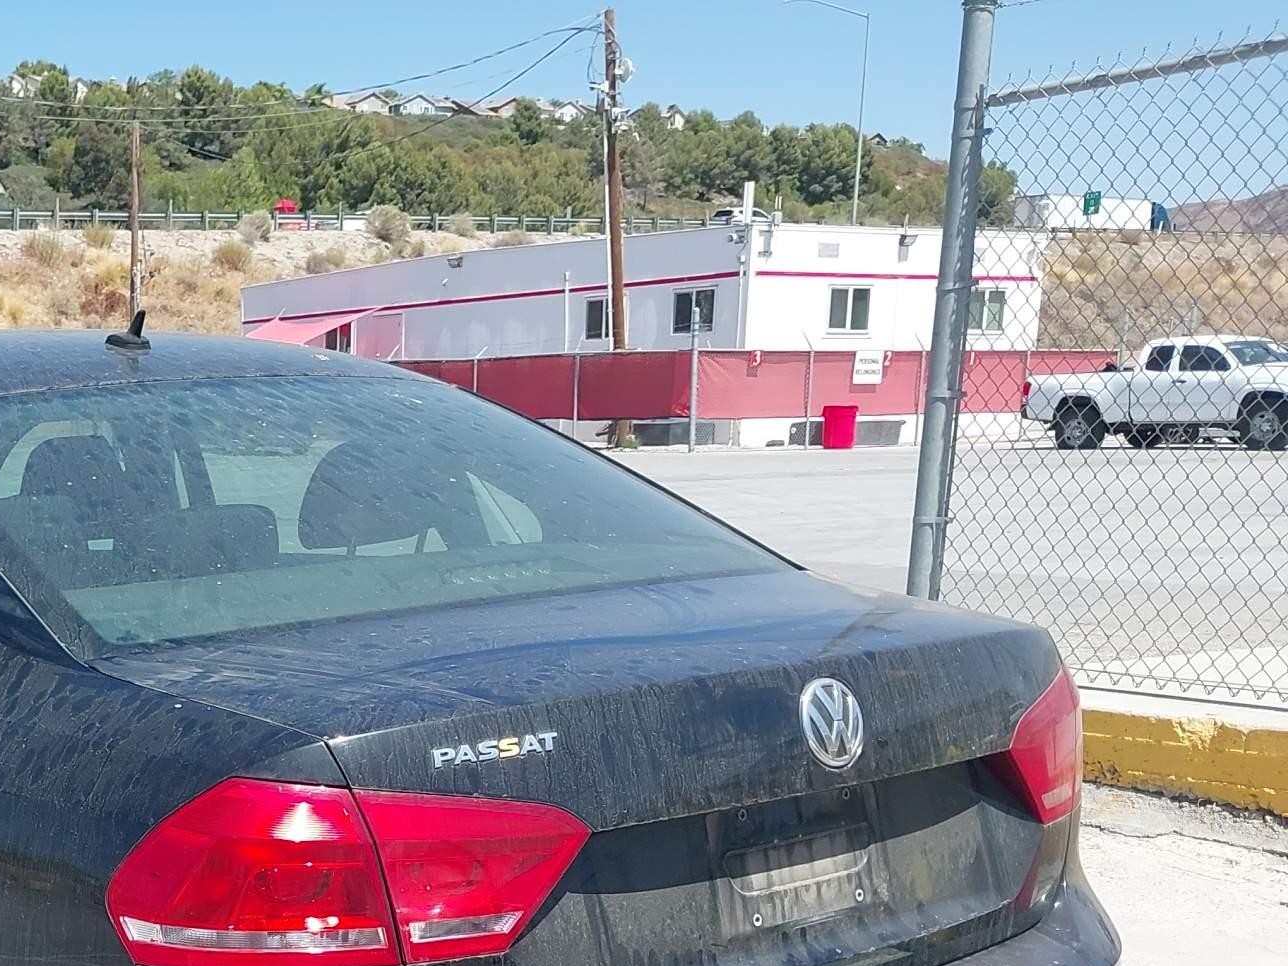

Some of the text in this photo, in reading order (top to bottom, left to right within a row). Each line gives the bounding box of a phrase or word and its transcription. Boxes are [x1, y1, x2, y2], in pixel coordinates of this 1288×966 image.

[752, 350, 760, 366] 3
[883, 350, 892, 366] 2
[969, 350, 975, 366] 1
[432, 731, 558, 768] PASSAT
